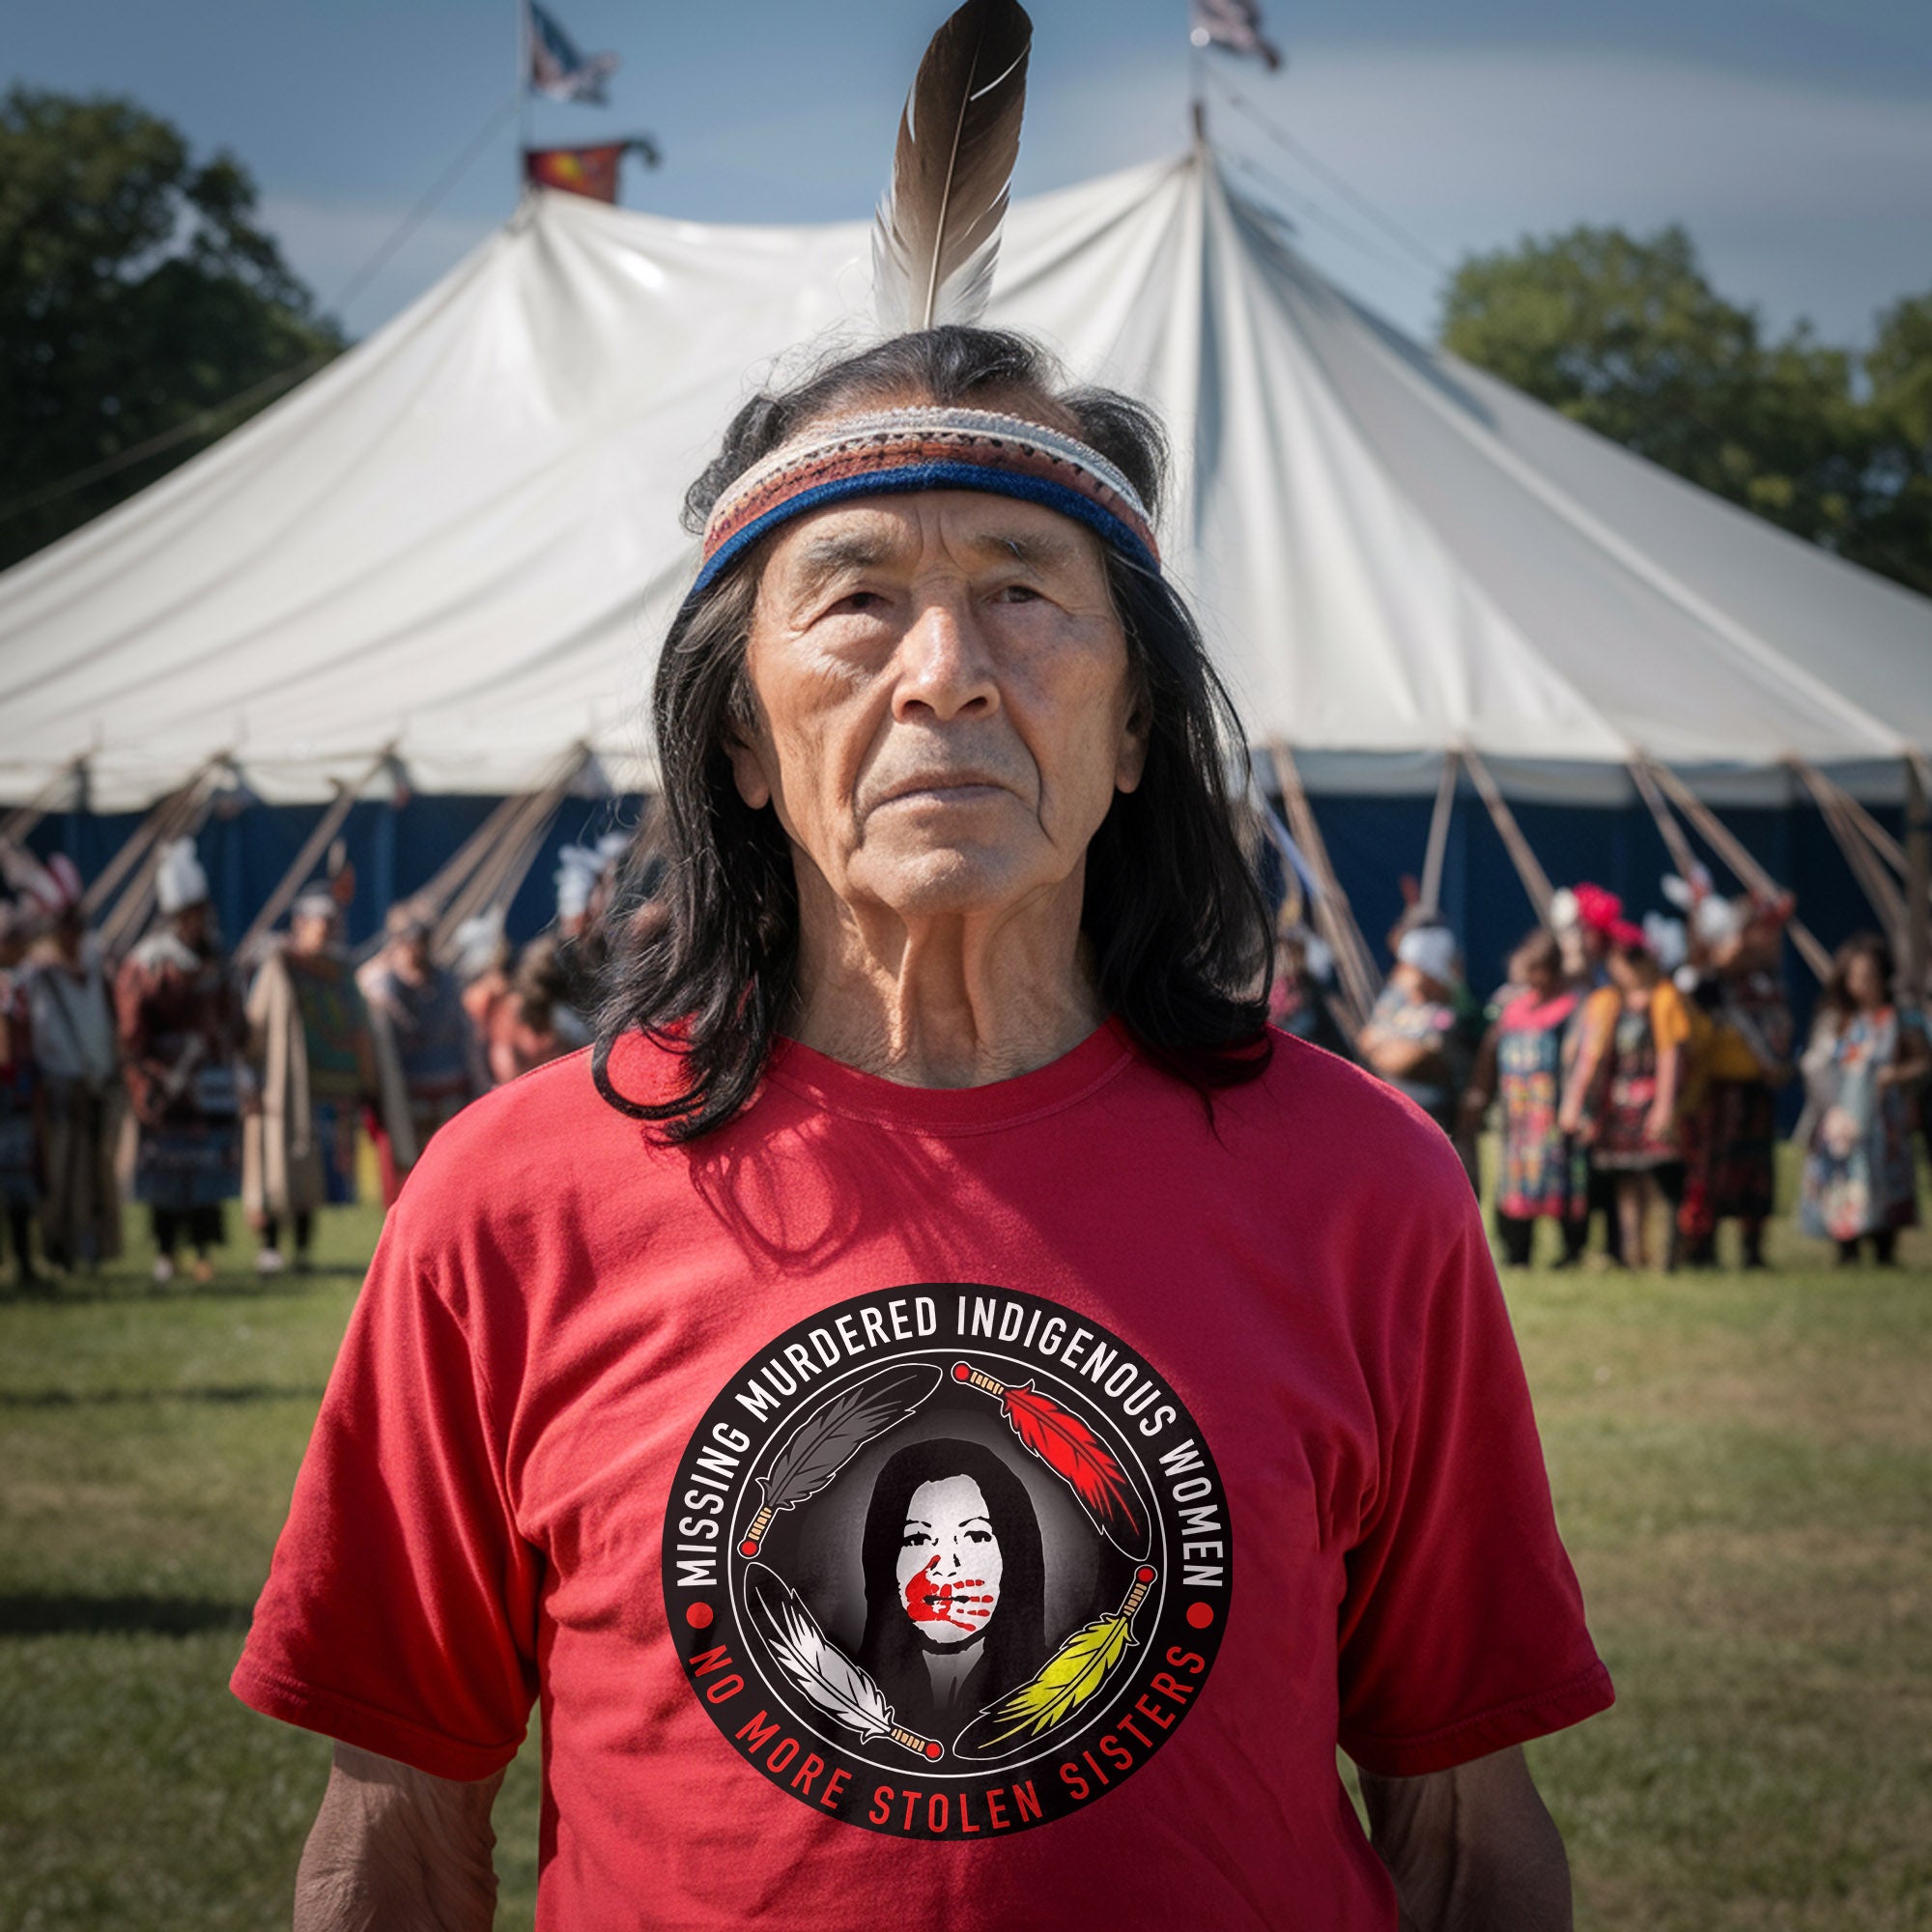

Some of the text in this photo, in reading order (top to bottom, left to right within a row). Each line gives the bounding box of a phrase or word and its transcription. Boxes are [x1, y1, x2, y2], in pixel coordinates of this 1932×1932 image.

[677, 1295, 1223, 1587] MISSING MURDERED INDIGENOUS WOMEN
[689, 1643, 1206, 1833] NO MORE STOLEN SISTERS
